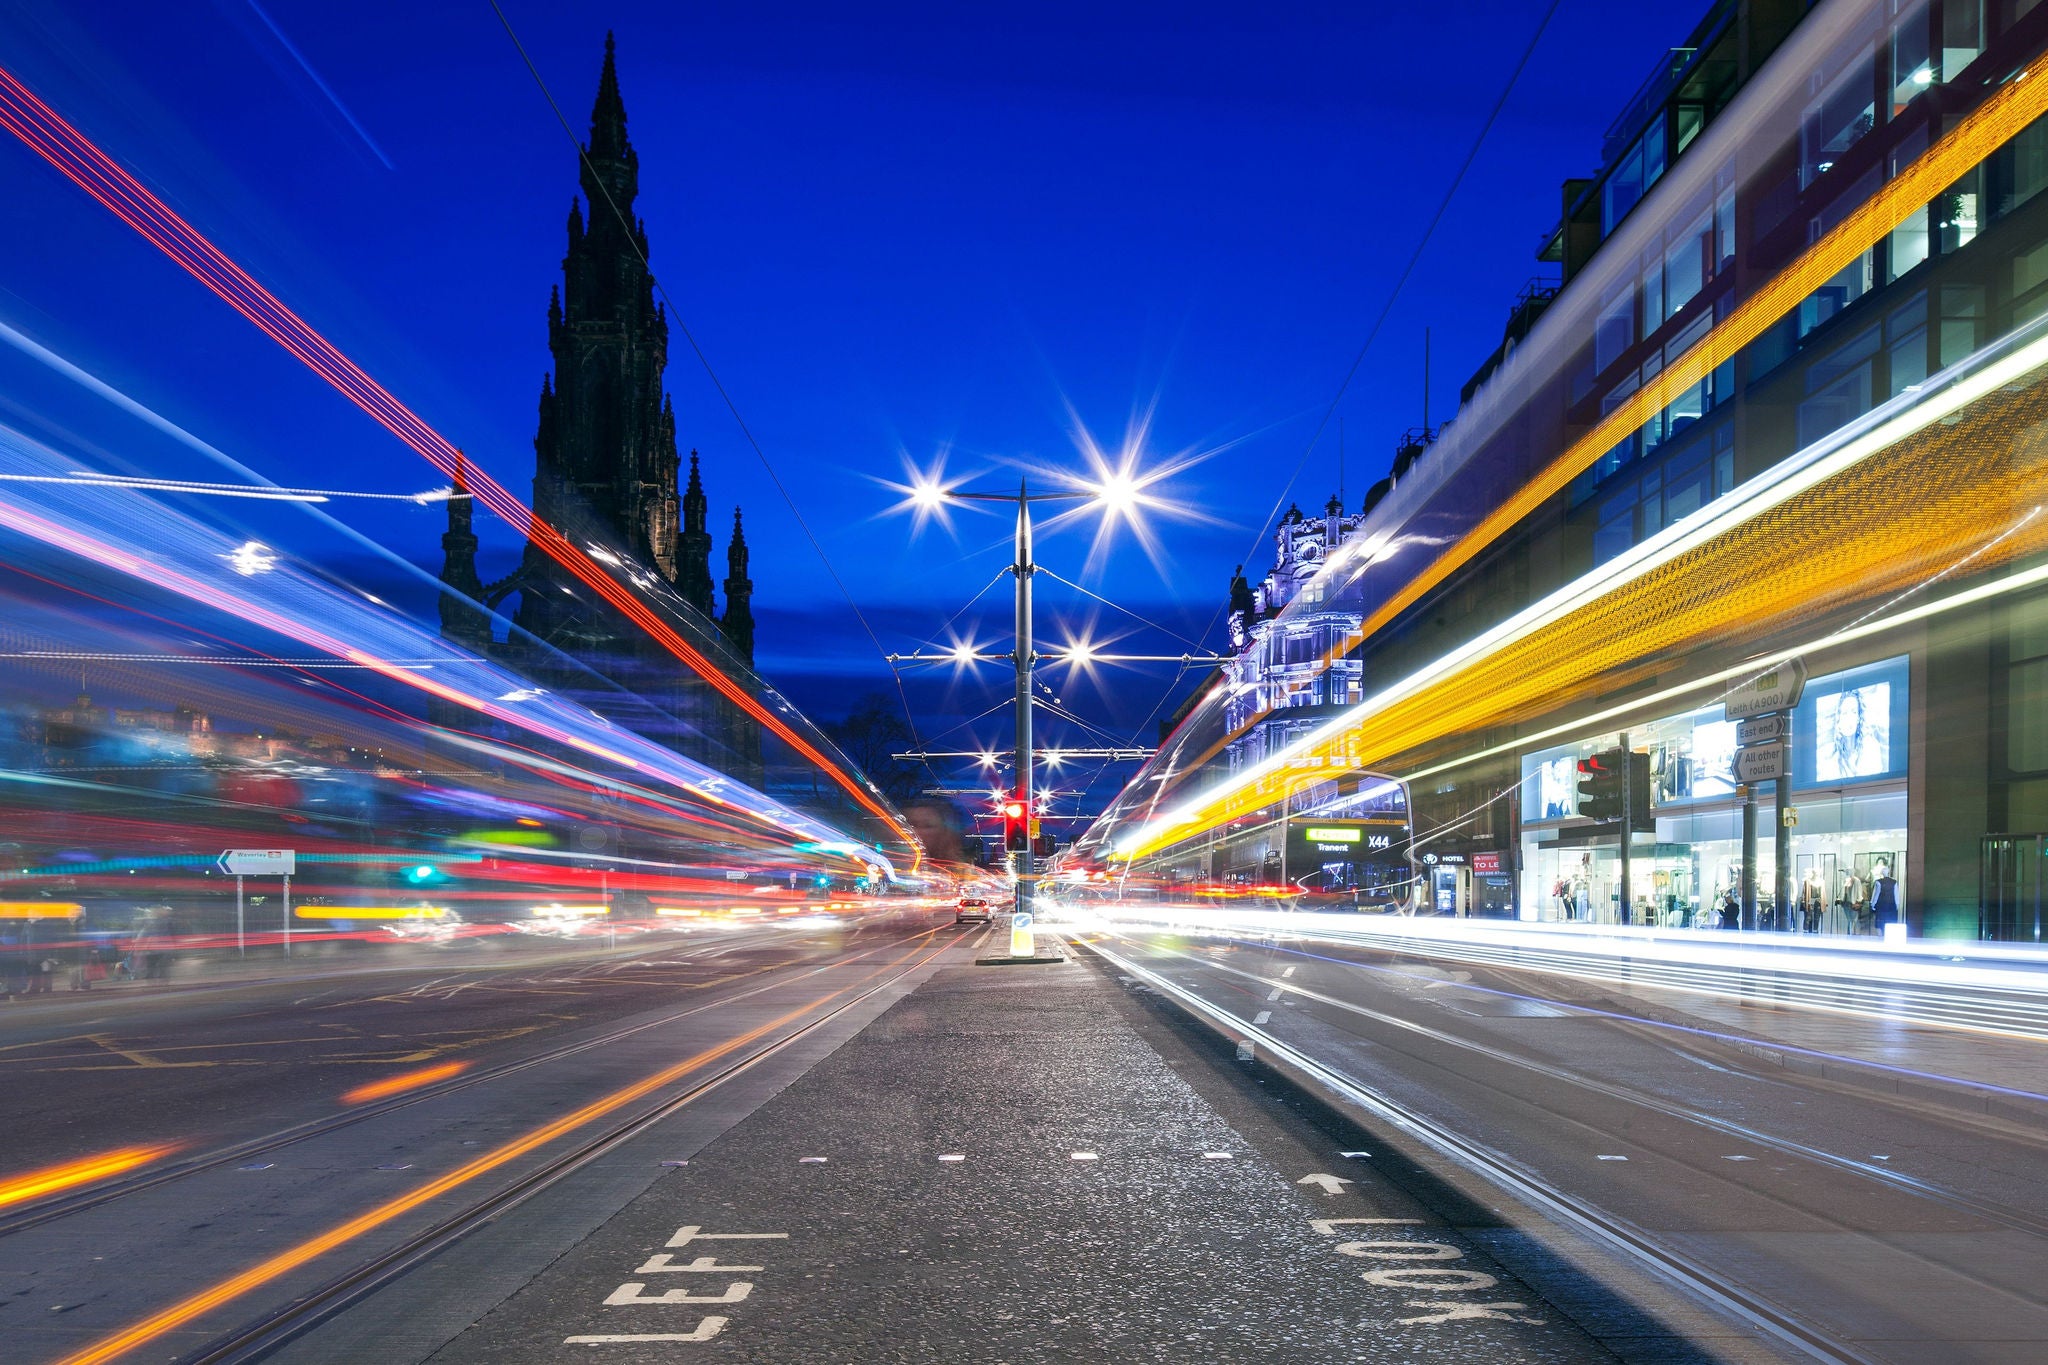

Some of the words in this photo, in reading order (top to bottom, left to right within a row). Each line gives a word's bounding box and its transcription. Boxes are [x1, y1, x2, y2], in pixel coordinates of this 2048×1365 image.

[1729, 702, 1748, 715] Leith
[1750, 692, 1784, 711] (A900)
[1739, 728, 1757, 739] East
[1758, 723, 1774, 735] end
[1745, 752, 1757, 763] All
[1758, 749, 1780, 761] other
[1749, 763, 1775, 775] routes
[1317, 843, 1349, 852] Tranent
[1368, 835, 1390, 848] X44
[1308, 1218, 1547, 1325] LOOK
[563, 1225, 790, 1344] LEFT
